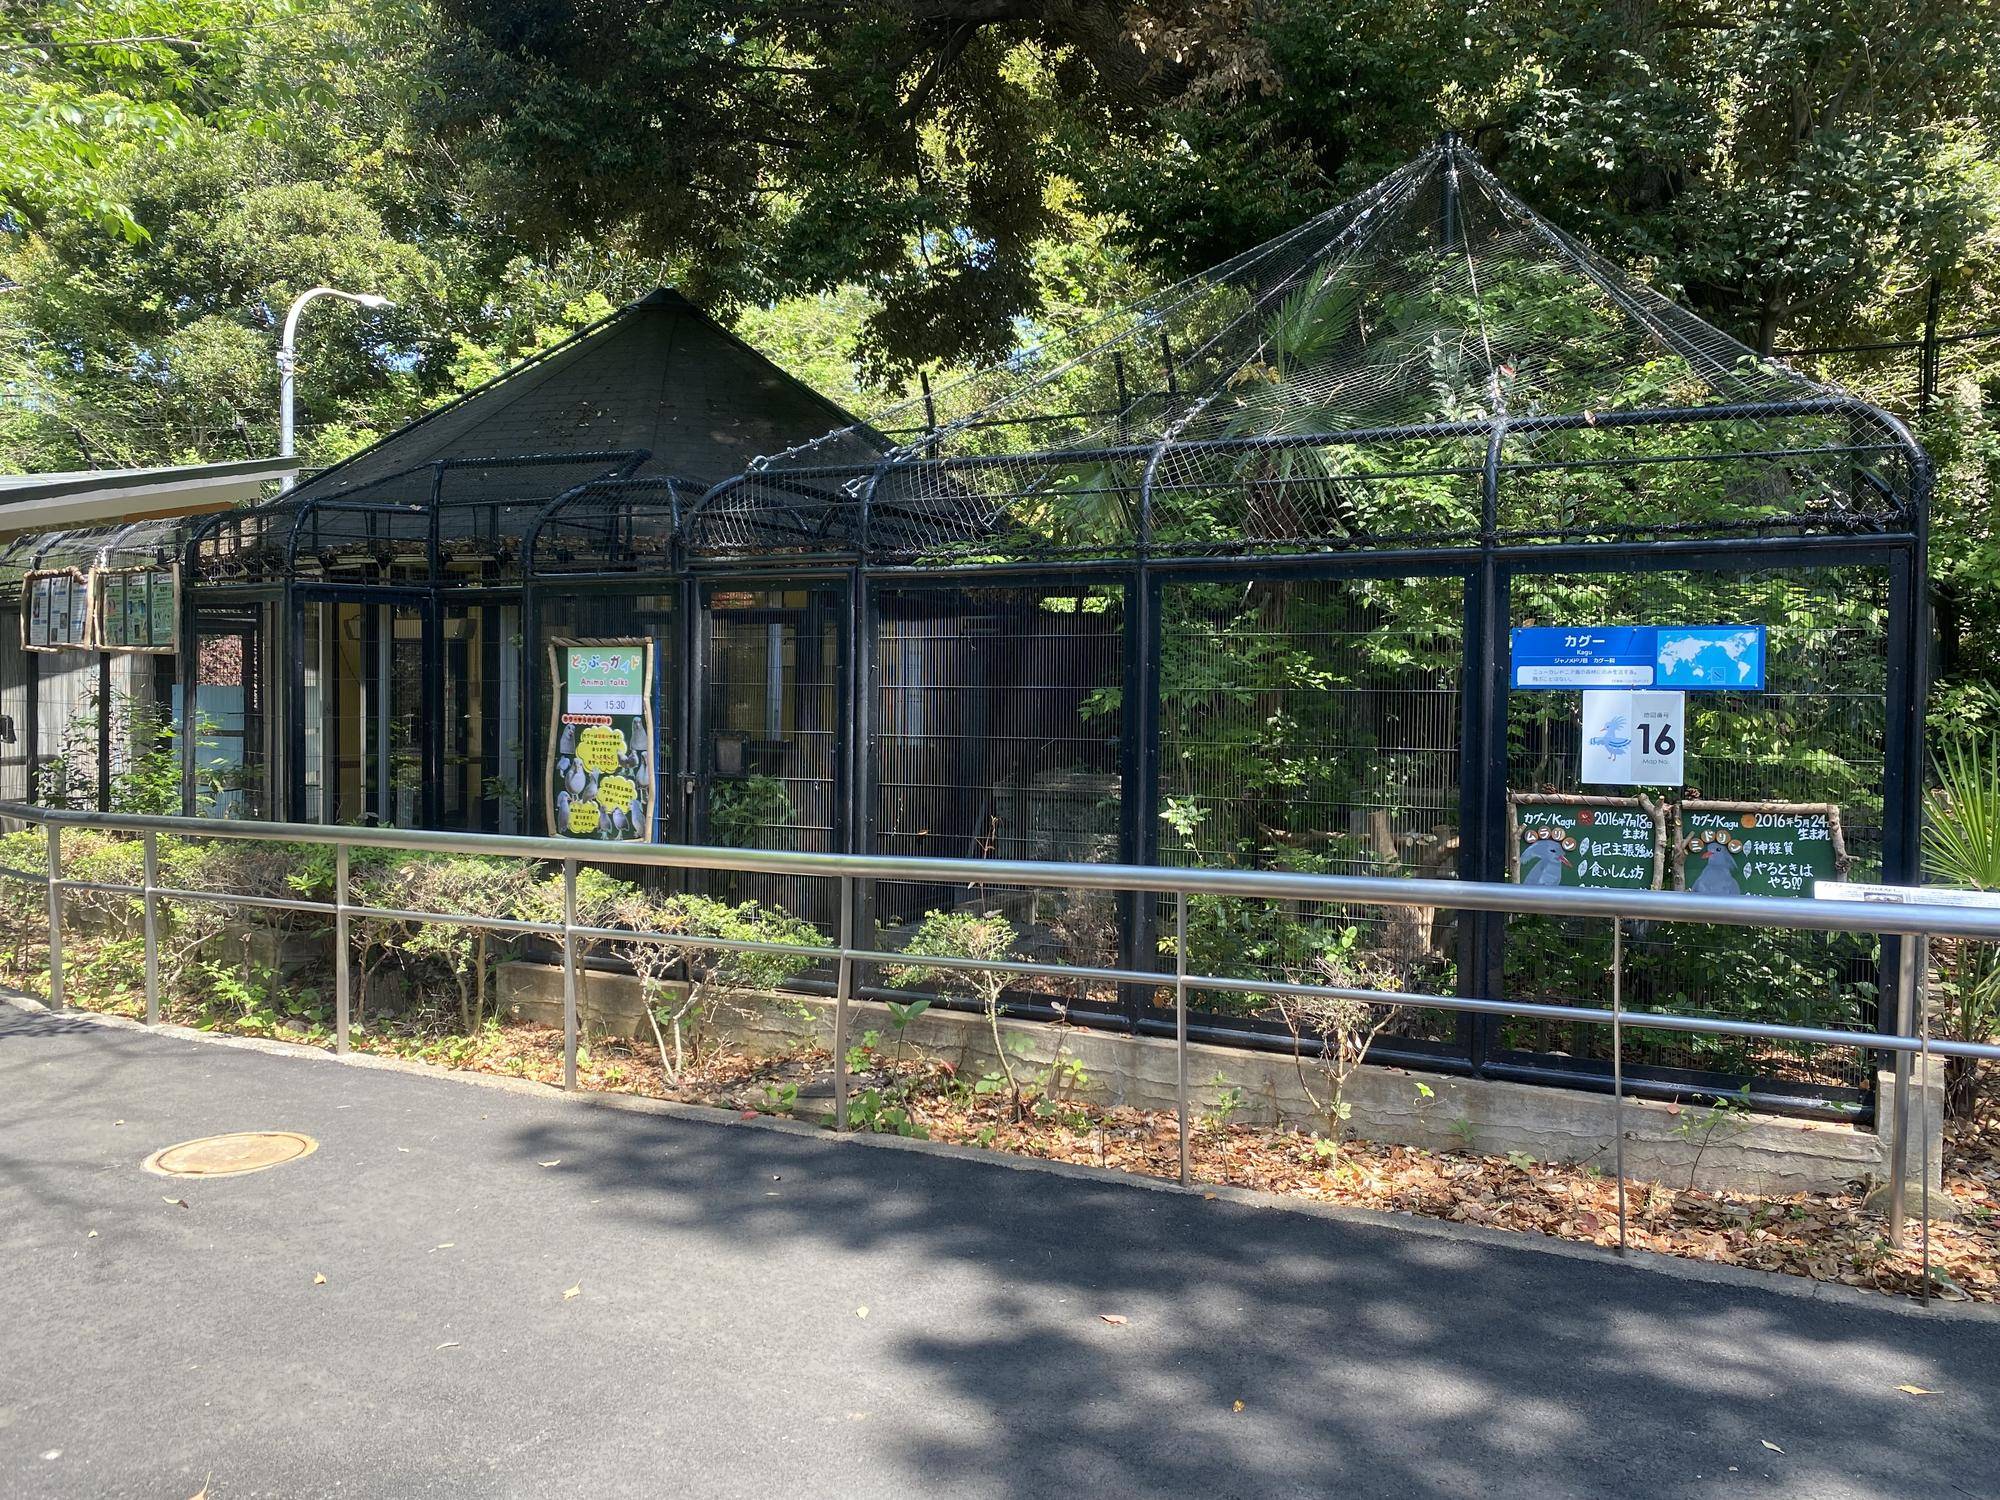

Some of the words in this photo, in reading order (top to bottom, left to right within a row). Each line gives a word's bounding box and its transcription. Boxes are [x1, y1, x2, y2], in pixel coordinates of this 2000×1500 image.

[1564, 635, 1605, 648] カグー
[571, 654, 640, 674] どうぶつガイド
[580, 678, 605, 687] Animal
[610, 678, 629, 687] talks
[583, 699, 593, 711] 火
[605, 700, 626, 710] 15:30
[1636, 723, 1676, 756] 16
[1642, 759, 1658, 767] Map
[1524, 812, 1576, 829] カグー/Kagu
[1691, 813, 1739, 831] カグー/Kagu
[1622, 828, 1649, 840] 生まれ
[1797, 828, 1831, 841] 生まれ
[1591, 841, 1654, 858] 自己主張強め
[1753, 840, 1794, 856] 神経質
[1588, 861, 1645, 880] 食いしん坊
[1754, 862, 1814, 877] やるときは
